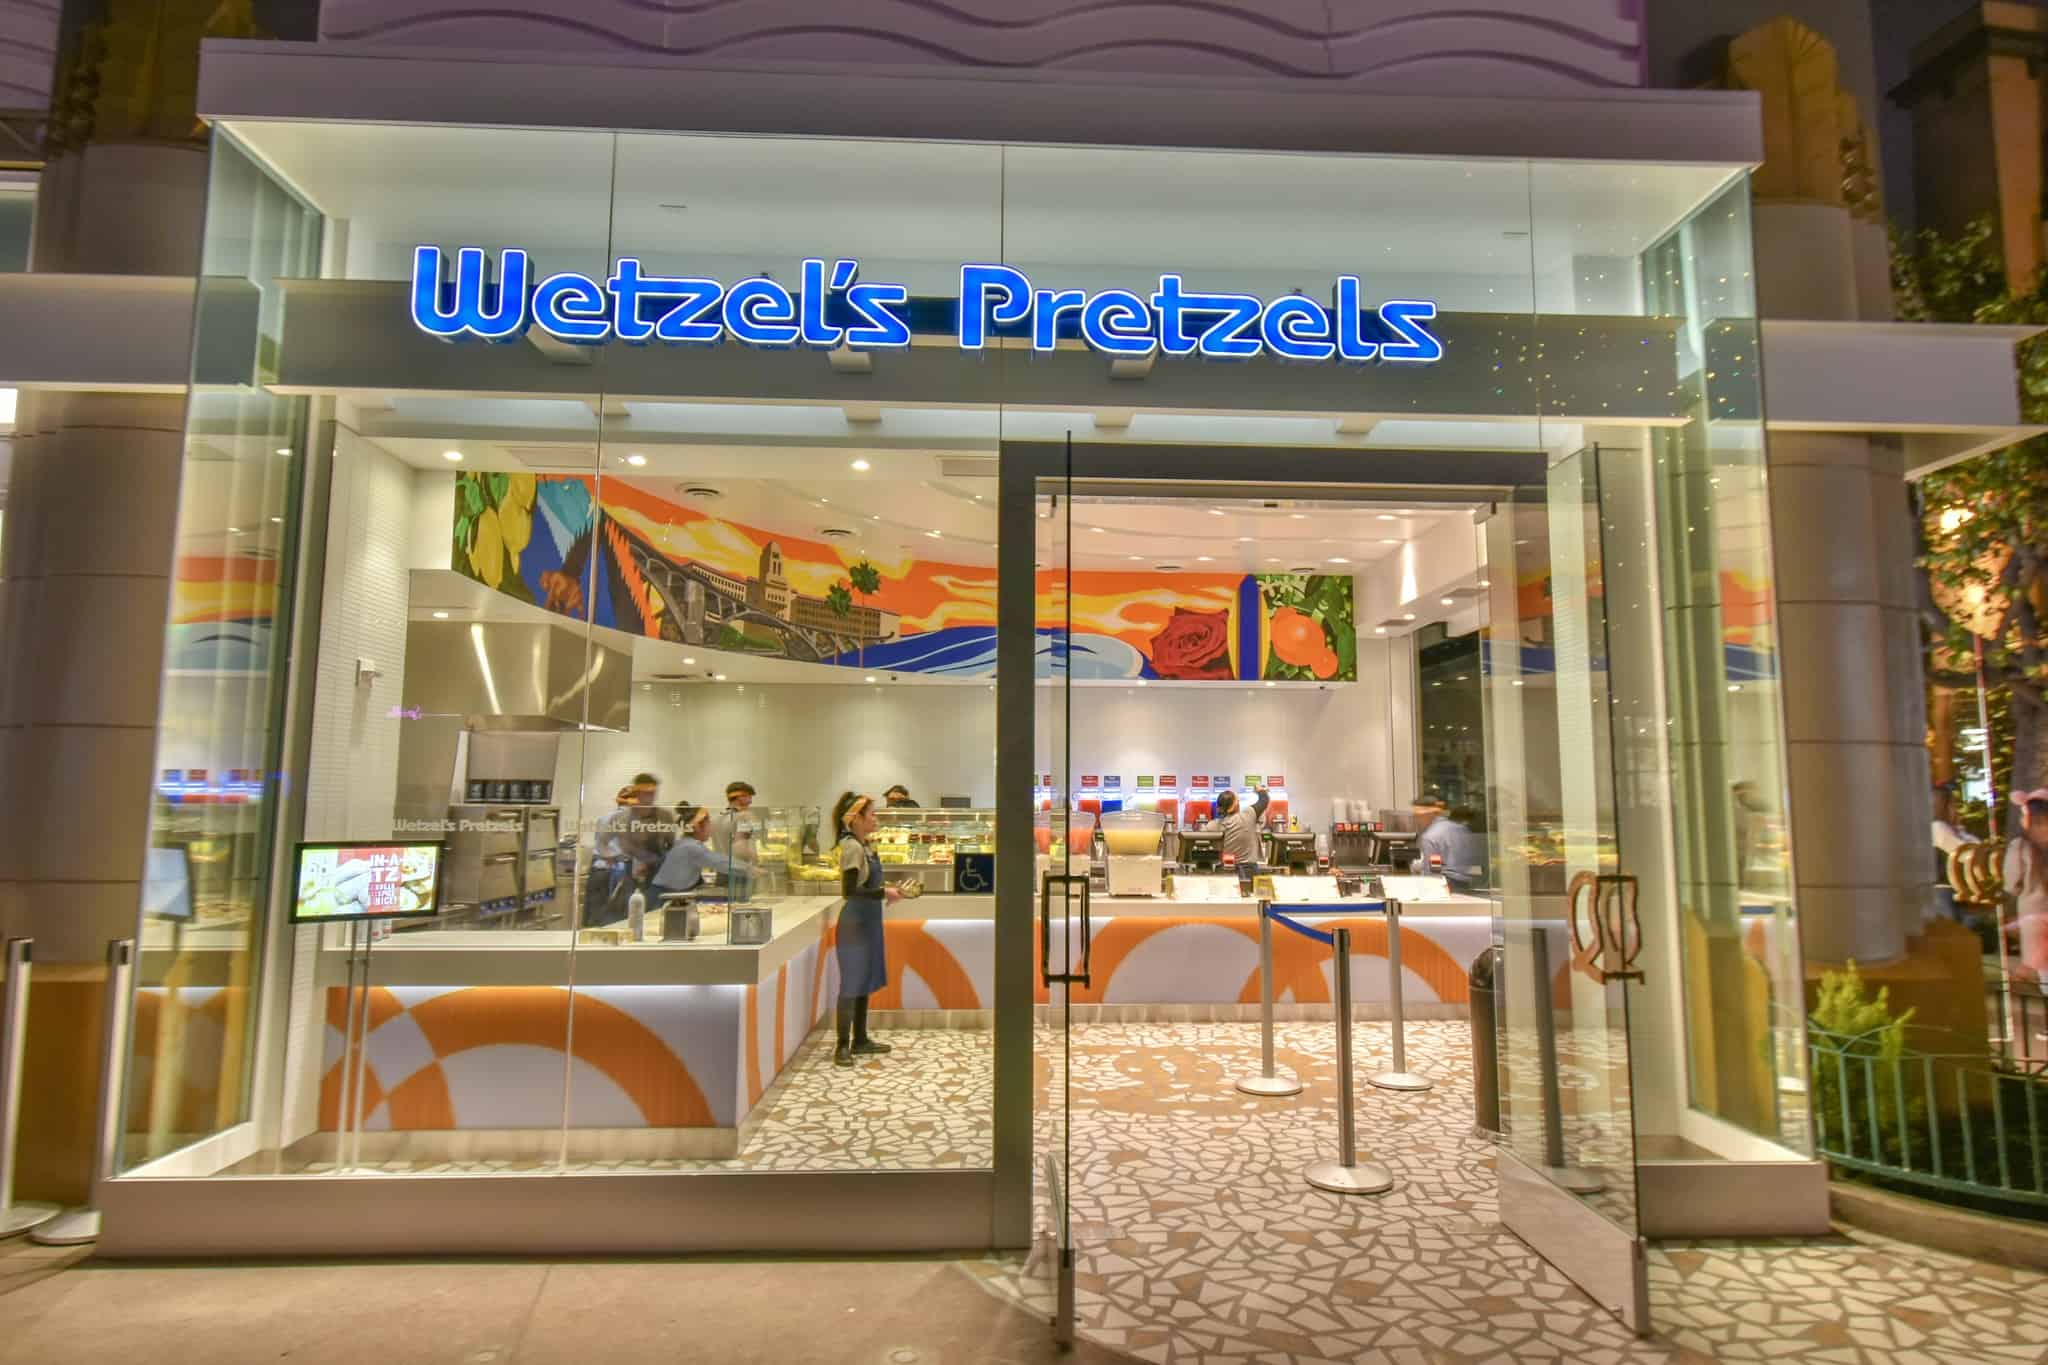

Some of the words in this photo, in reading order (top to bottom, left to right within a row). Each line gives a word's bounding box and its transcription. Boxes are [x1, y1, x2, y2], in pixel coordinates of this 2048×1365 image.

[411, 245, 911, 349] Wetzel's
[957, 263, 1443, 363] Pretzels
[394, 819, 456, 832] Wetzel's
[460, 819, 524, 832] Pretzels
